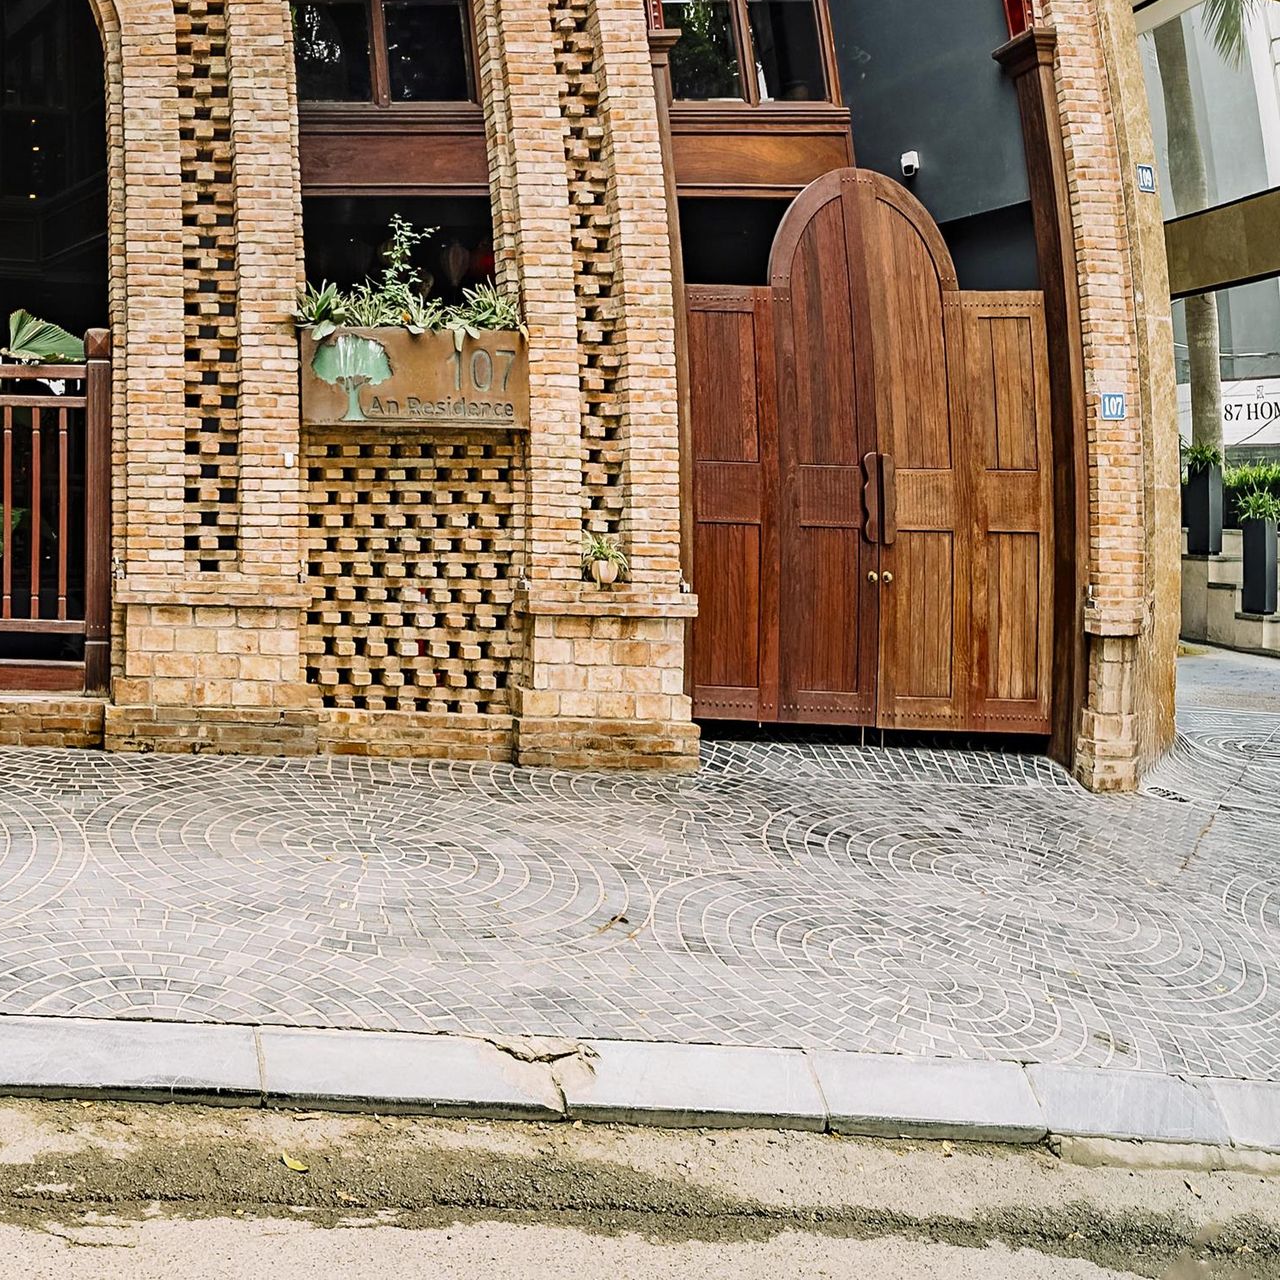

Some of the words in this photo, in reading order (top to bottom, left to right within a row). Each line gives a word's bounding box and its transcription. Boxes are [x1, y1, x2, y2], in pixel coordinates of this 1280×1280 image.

[1138, 167, 1152, 188] 109
[446, 348, 516, 392] 107
[368, 396, 400, 415] An
[407, 396, 515, 417] Residence
[1104, 396, 1123, 416] 107
[1224, 403, 1243, 421] 87
